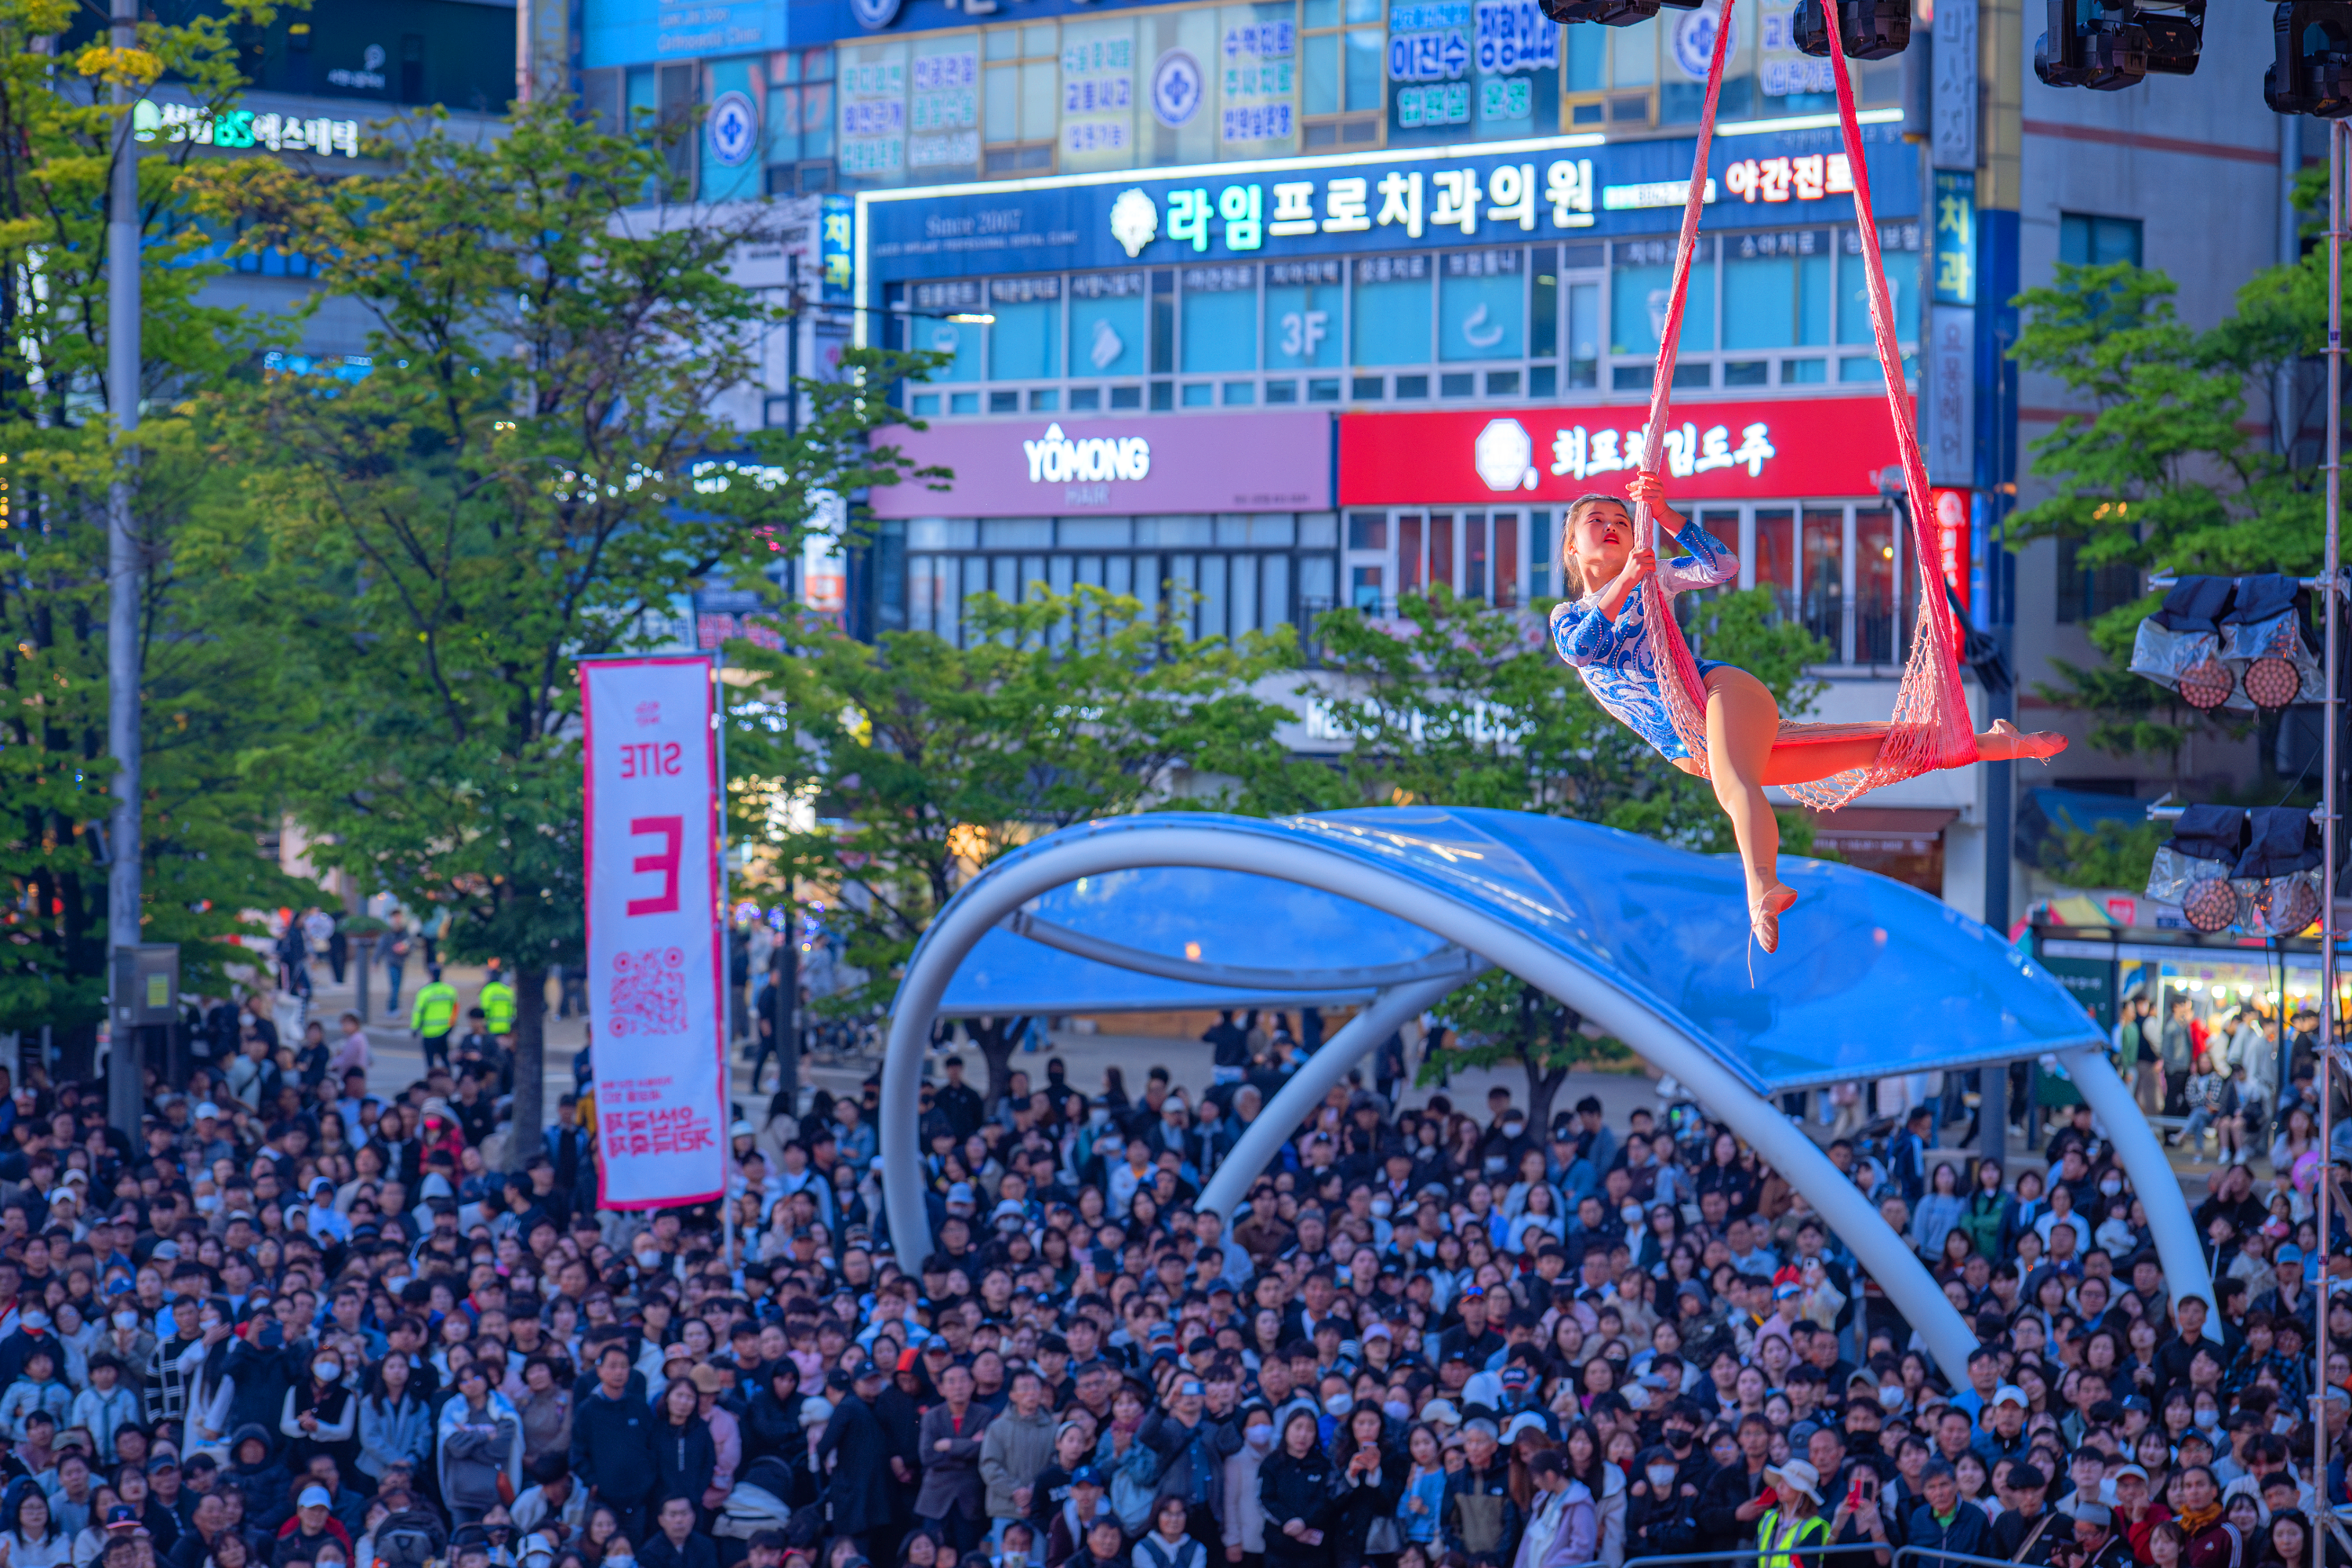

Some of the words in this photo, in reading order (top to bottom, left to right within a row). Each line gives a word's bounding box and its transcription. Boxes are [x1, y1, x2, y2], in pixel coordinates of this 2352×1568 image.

[1392, 34, 1465, 75] 이진수
[1066, 78, 1131, 112] 교통사고
[1726, 154, 1856, 201] 야간진료
[924, 214, 975, 237] Since
[1167, 158, 1595, 252] 라임프로치과의원
[823, 213, 852, 290] 치과
[1937, 194, 1973, 299] 치과
[1280, 310, 1328, 355] 3F
